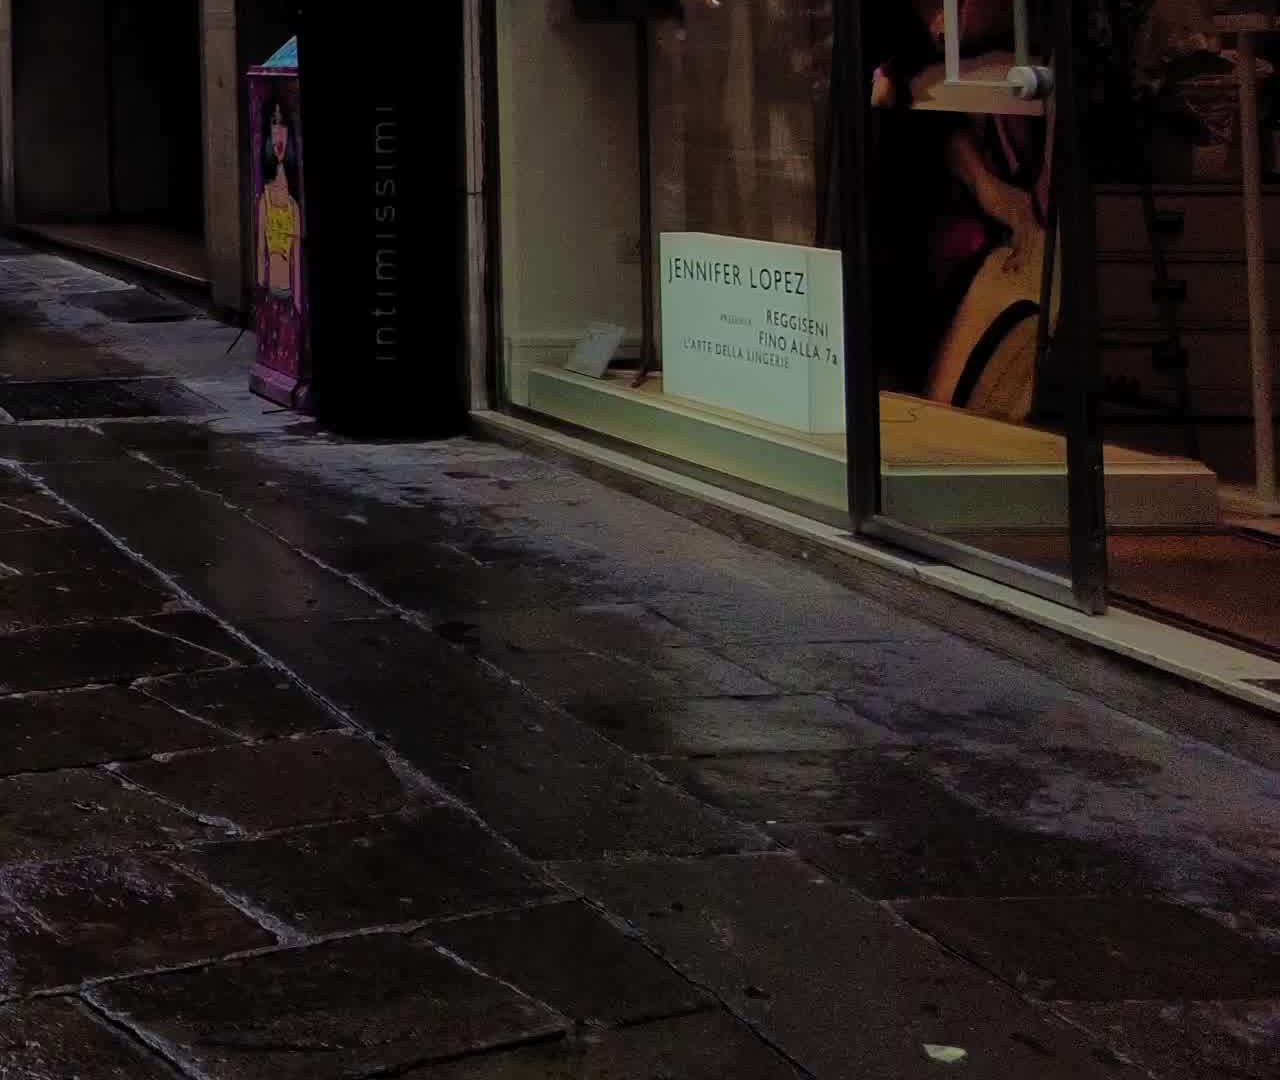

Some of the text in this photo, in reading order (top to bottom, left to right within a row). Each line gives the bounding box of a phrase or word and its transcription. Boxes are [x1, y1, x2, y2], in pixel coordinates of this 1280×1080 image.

[668, 258, 806, 295] JENNIFER LOPEZ
[766, 309, 829, 338] REGGISENI
[715, 343, 744, 360] DELLA
[758, 330, 787, 352] FINO
[790, 338, 821, 361] ALLA
